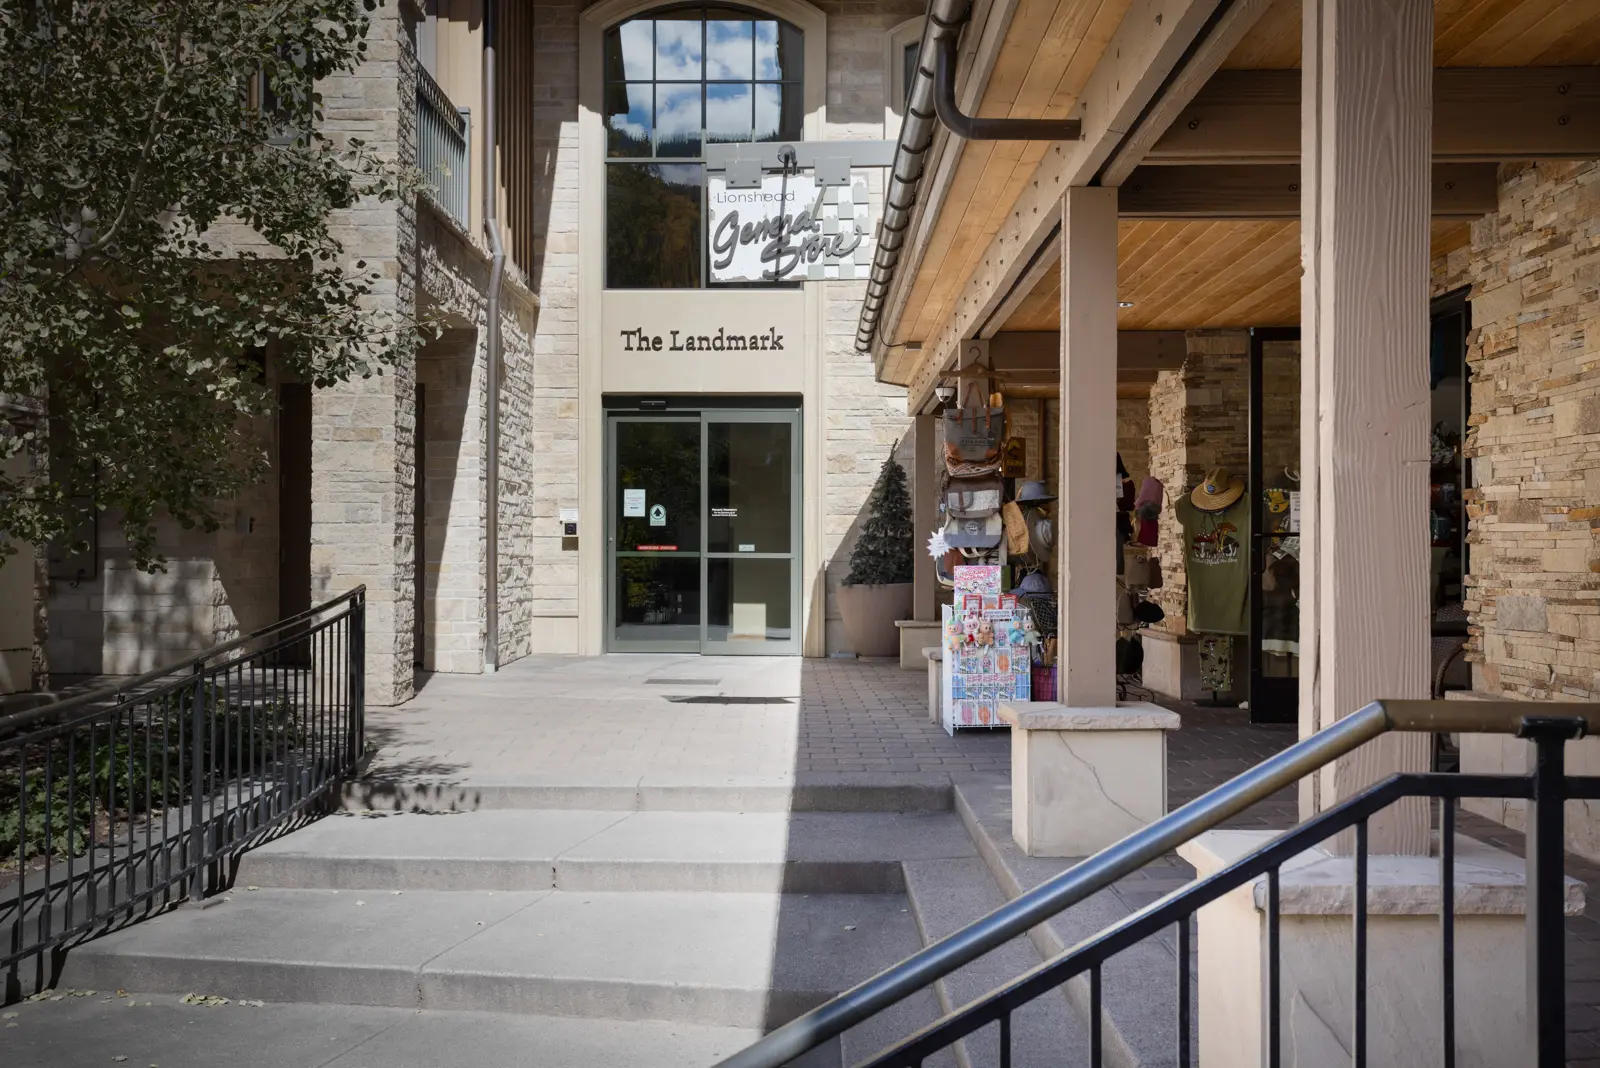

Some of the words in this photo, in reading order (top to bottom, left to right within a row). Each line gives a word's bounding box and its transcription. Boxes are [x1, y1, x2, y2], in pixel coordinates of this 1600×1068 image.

[716, 189, 796, 204] Lionshead
[713, 186, 825, 270] General
[760, 224, 863, 280] Store
[620, 327, 663, 351] The
[669, 326, 784, 351] Landmark
